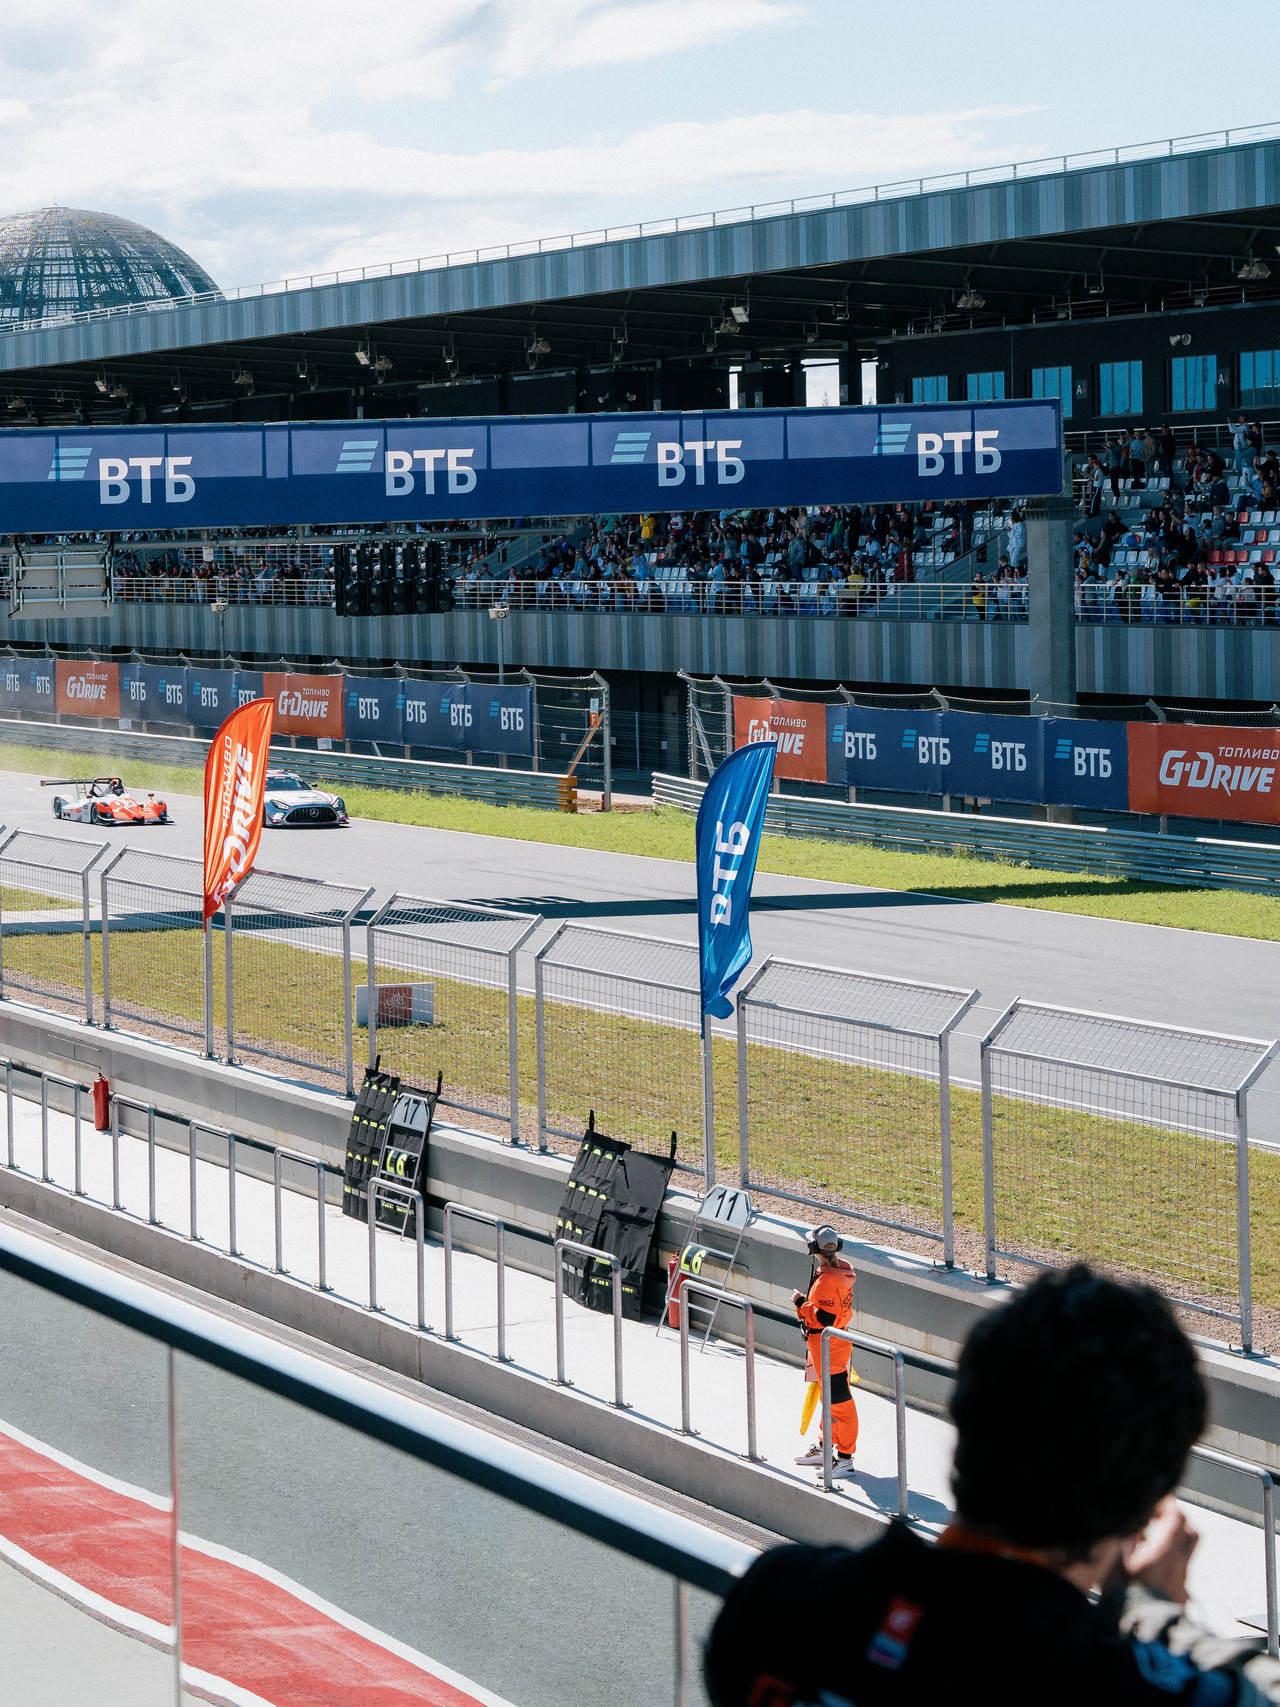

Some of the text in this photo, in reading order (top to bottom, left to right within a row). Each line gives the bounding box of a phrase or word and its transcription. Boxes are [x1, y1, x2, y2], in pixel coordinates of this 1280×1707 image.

[657, 440, 745, 487] ВТБ
[917, 430, 1001, 477] ВТБ
[99, 456, 196, 505] ВТБ
[385, 448, 477, 496] ВТБ
[6, 673, 19, 692] ВТБ
[36, 676, 51, 695] ВТБ
[130, 681, 146, 701] ВТБ
[166, 684, 183, 705] ВТБ
[201, 686, 218, 708] ВТБ
[358, 697, 380, 720] ВТБ
[406, 700, 427, 724] ВТБ
[450, 703, 472, 727] ВТБ
[500, 707, 524, 731] ВТБ
[844, 731, 877, 760] ВТБ
[918, 736, 951, 765] ВТБ
[991, 741, 1027, 771] ВТБ
[1074, 746, 1112, 778] ВТБ
[710, 821, 751, 926] ВТБ
[404, 1097, 421, 1126] 17
[715, 1190, 739, 1221] 11
[680, 1244, 707, 1275] L6
